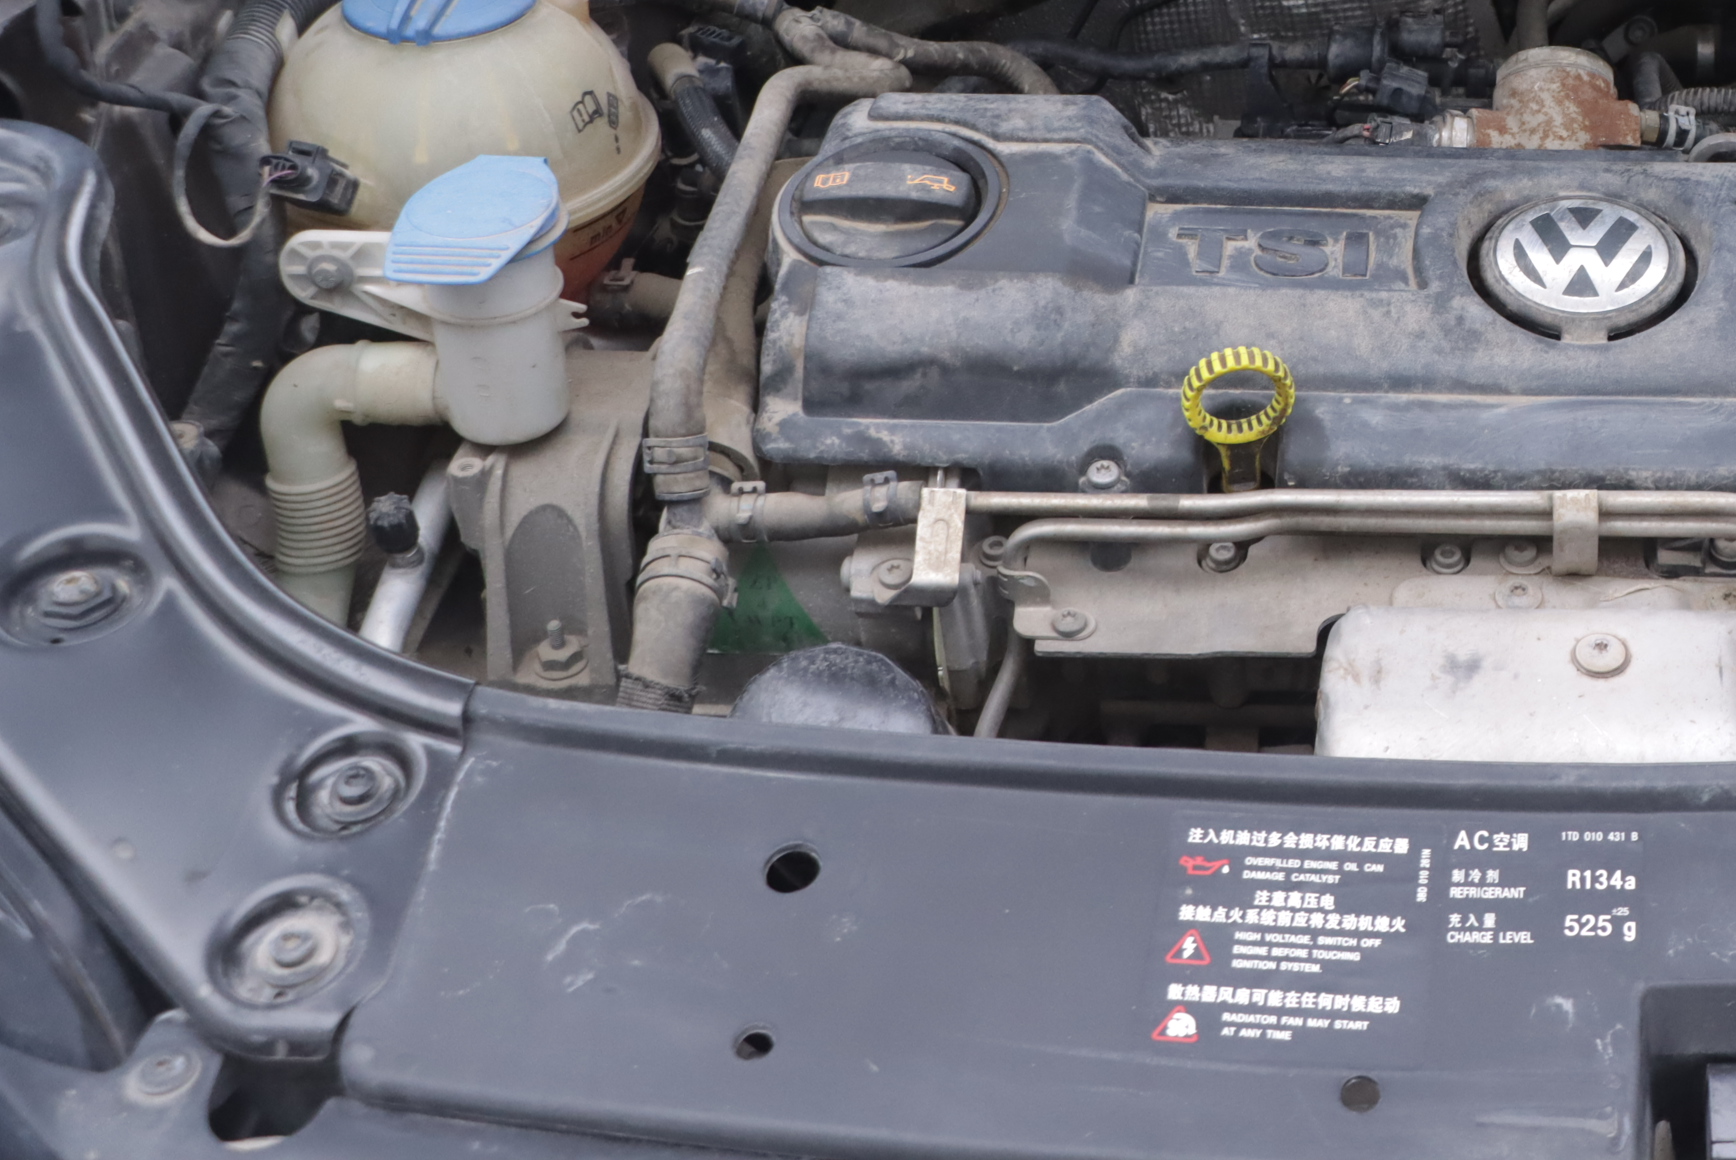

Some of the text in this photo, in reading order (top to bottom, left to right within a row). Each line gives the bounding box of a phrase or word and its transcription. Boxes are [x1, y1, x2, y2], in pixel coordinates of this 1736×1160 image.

[1176, 227, 1373, 278] TSI
[1502, 202, 1664, 304] VW
[1188, 828, 1409, 854] 注入机油过多会损坏催化反应器
[1562, 832, 1639, 841] 1TD 010 431 B
[1245, 857, 1384, 872] OVERFILLED ENGINE OIL CAN
[1243, 870, 1341, 884] DAMAGE CATALYST
[1419, 870, 1429, 884] 010
[1451, 869, 1499, 883] 制冷剂
[1567, 870, 1636, 890] R134a
[1254, 891, 1335, 910] 注意高压电
[1450, 887, 1526, 899] REFRIGERANT
[1178, 905, 1406, 933] 接触点火系统前应将发动机熄火
[1448, 913, 1496, 929] 充入量
[1564, 915, 1612, 937] 525
[1622, 920, 1636, 941] g
[1235, 931, 1382, 948] HIGH VOLTAGE, SWITCH OFF
[1447, 932, 1534, 943] CHARGE LEVEL
[1232, 945, 1361, 961] ENGINE BEFORE TOUCHING
[1231, 959, 1322, 973] IGNITION SYSTEM.
[1167, 983, 1400, 1014] 散热器风扇可能在任何时候起动
[1222, 1012, 1369, 1030] RADIATOR FAN MAY START
[1221, 1027, 1292, 1040] AT ANY TIME
